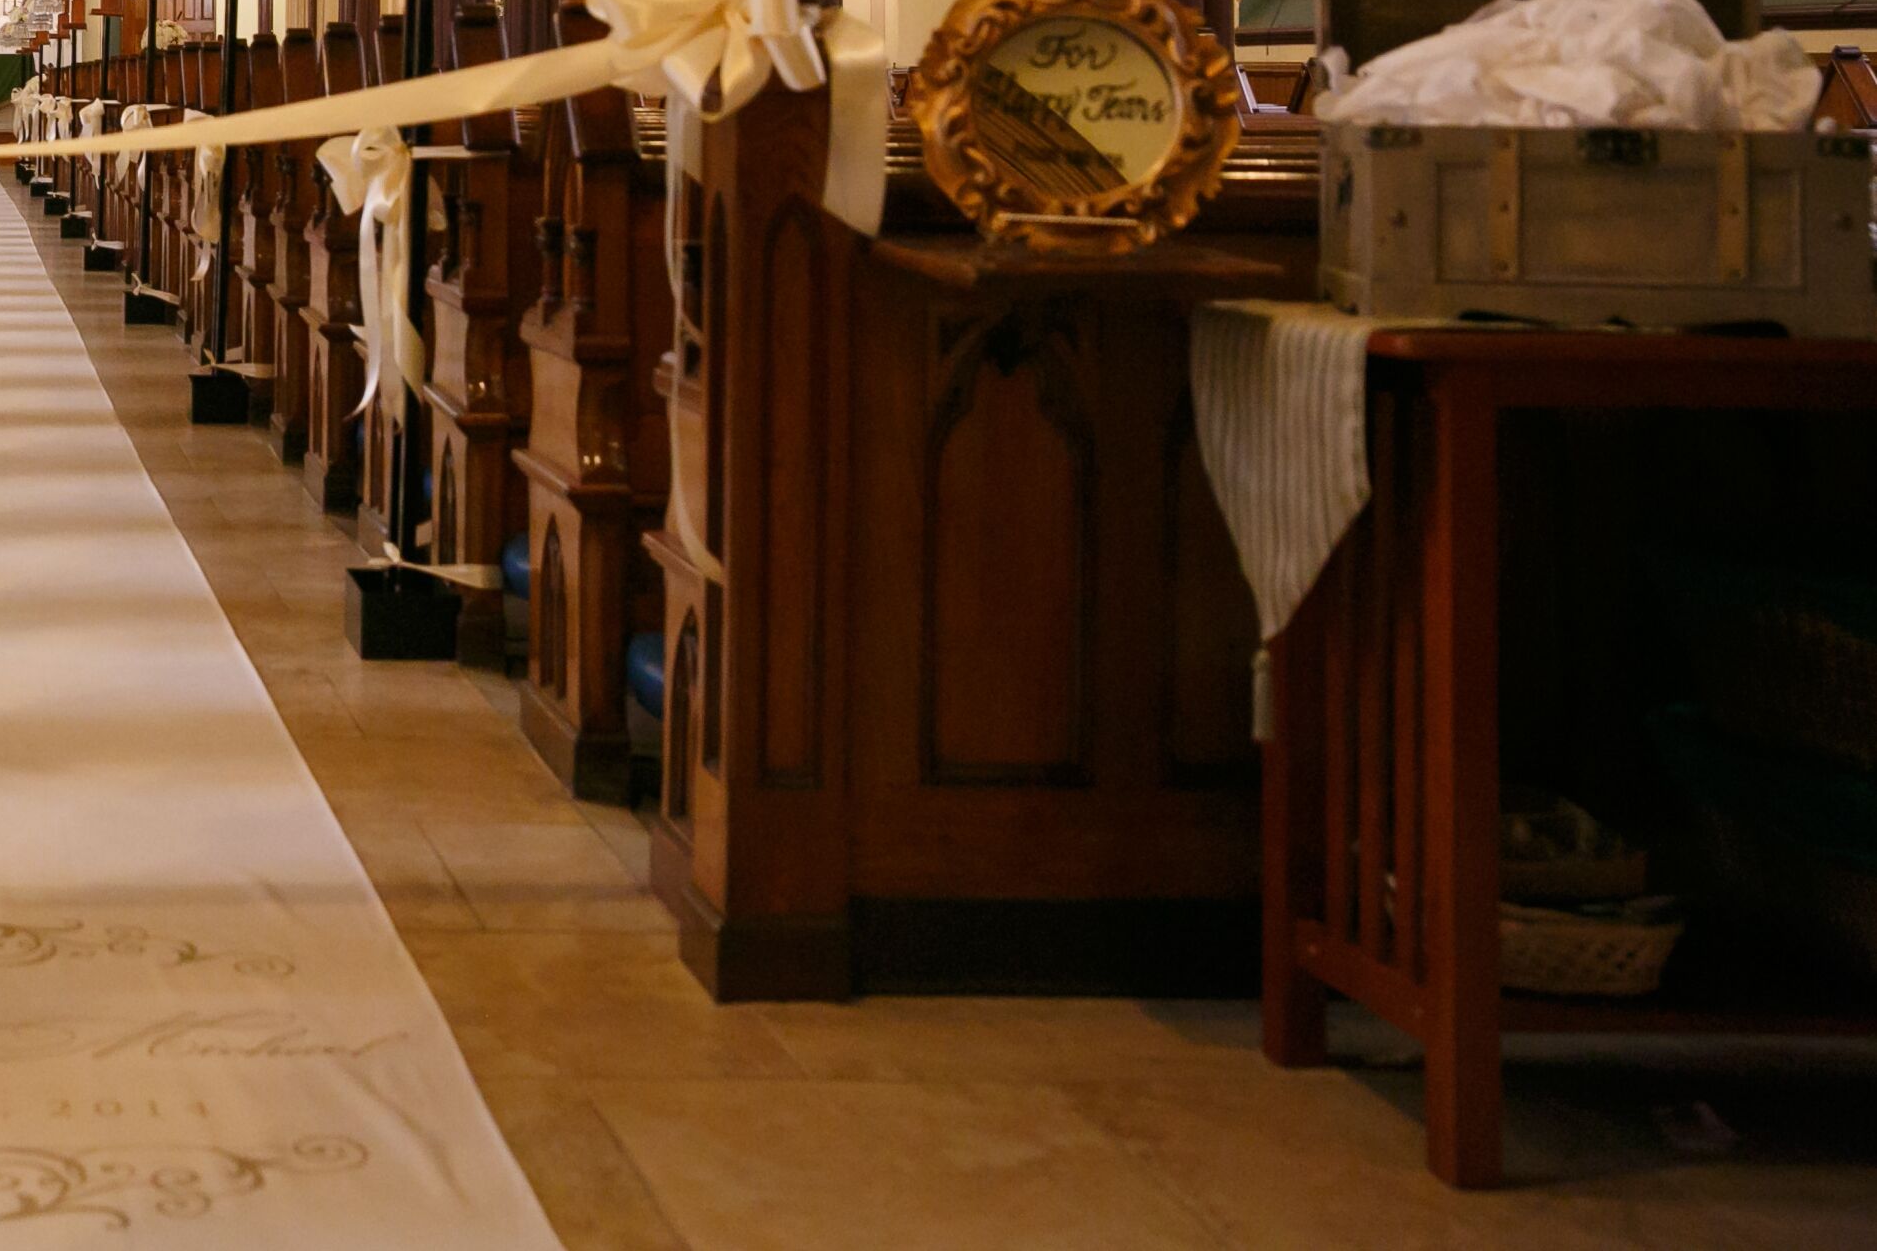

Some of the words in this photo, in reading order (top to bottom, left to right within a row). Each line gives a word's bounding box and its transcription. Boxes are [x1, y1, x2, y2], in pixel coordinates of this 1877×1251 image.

[1029, 27, 1117, 70] For
[1082, 79, 1165, 122] Tears
[47, 1098, 211, 1118] 2014
